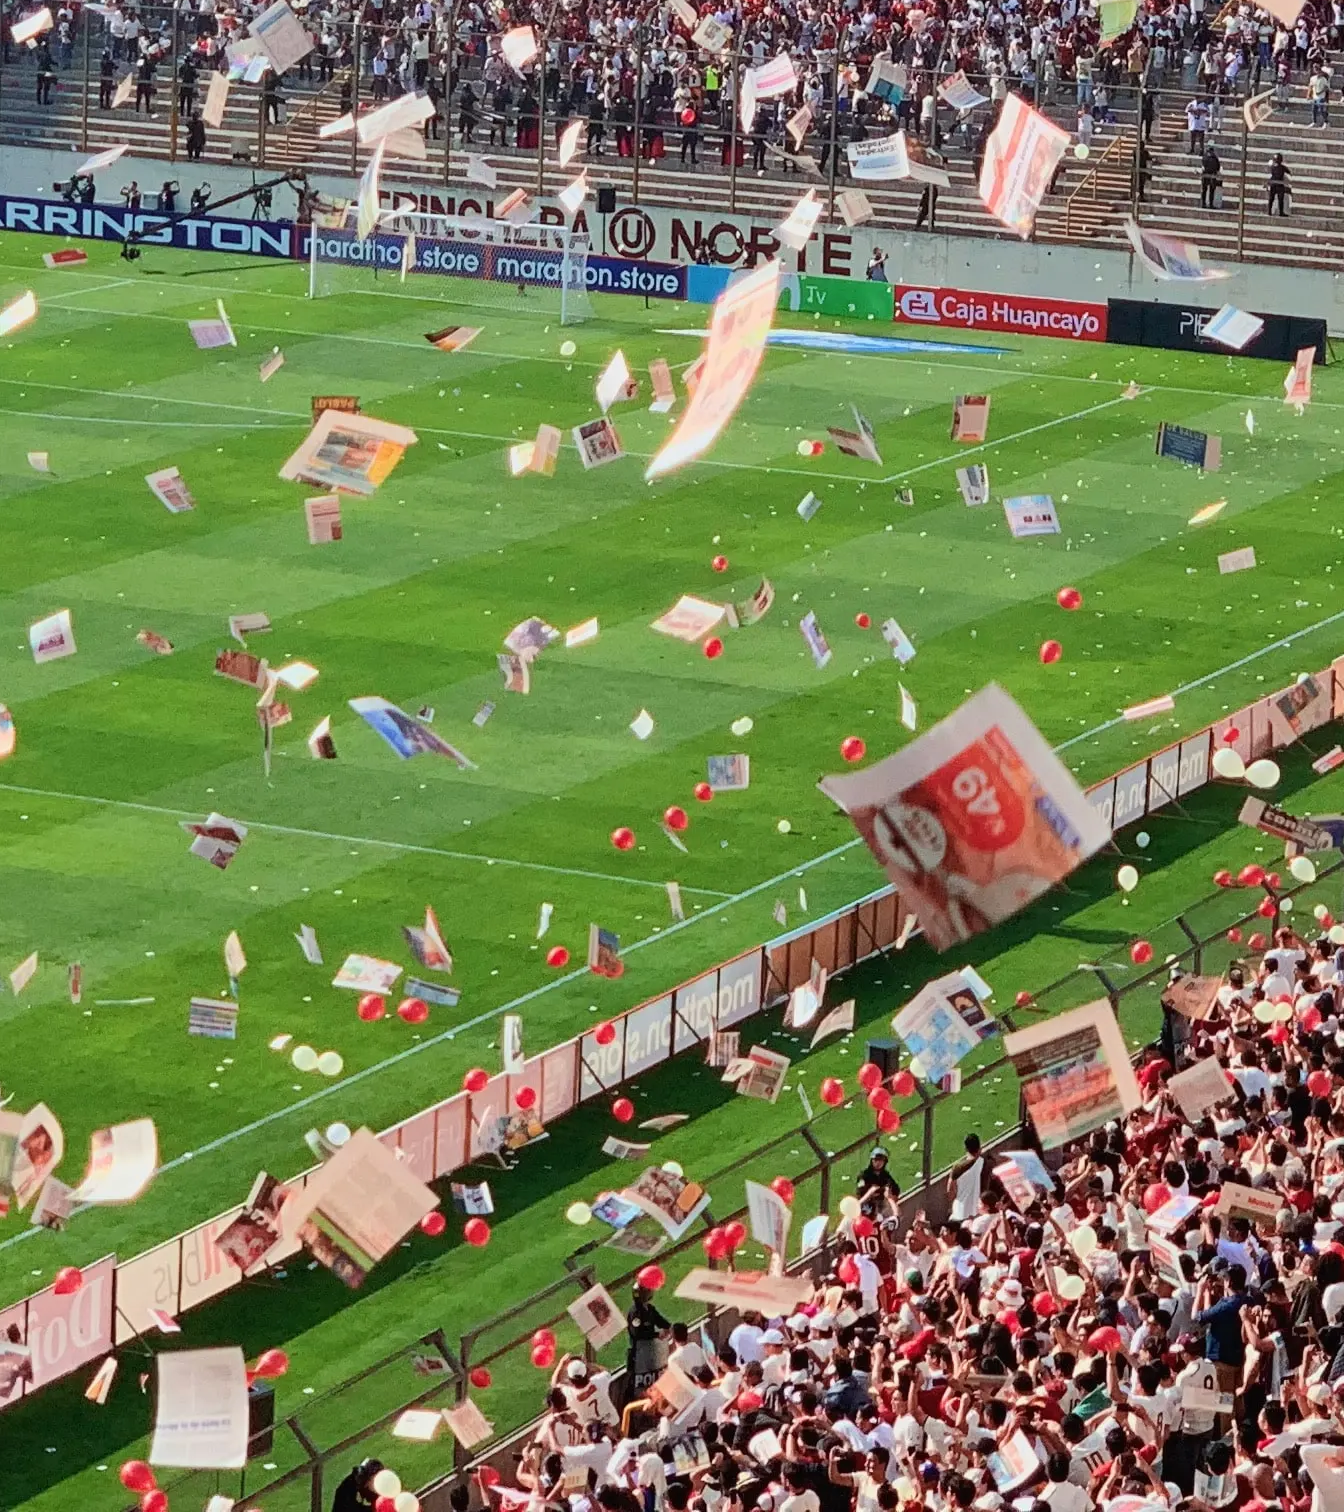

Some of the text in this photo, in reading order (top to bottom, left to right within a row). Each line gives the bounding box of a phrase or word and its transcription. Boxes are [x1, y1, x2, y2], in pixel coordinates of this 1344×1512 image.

[304, 236, 479, 274] maratho.store
[670, 218, 851, 276] NORTE
[941, 296, 1100, 337] Caja Huancayo
[859, 1236, 879, 1255] 10
